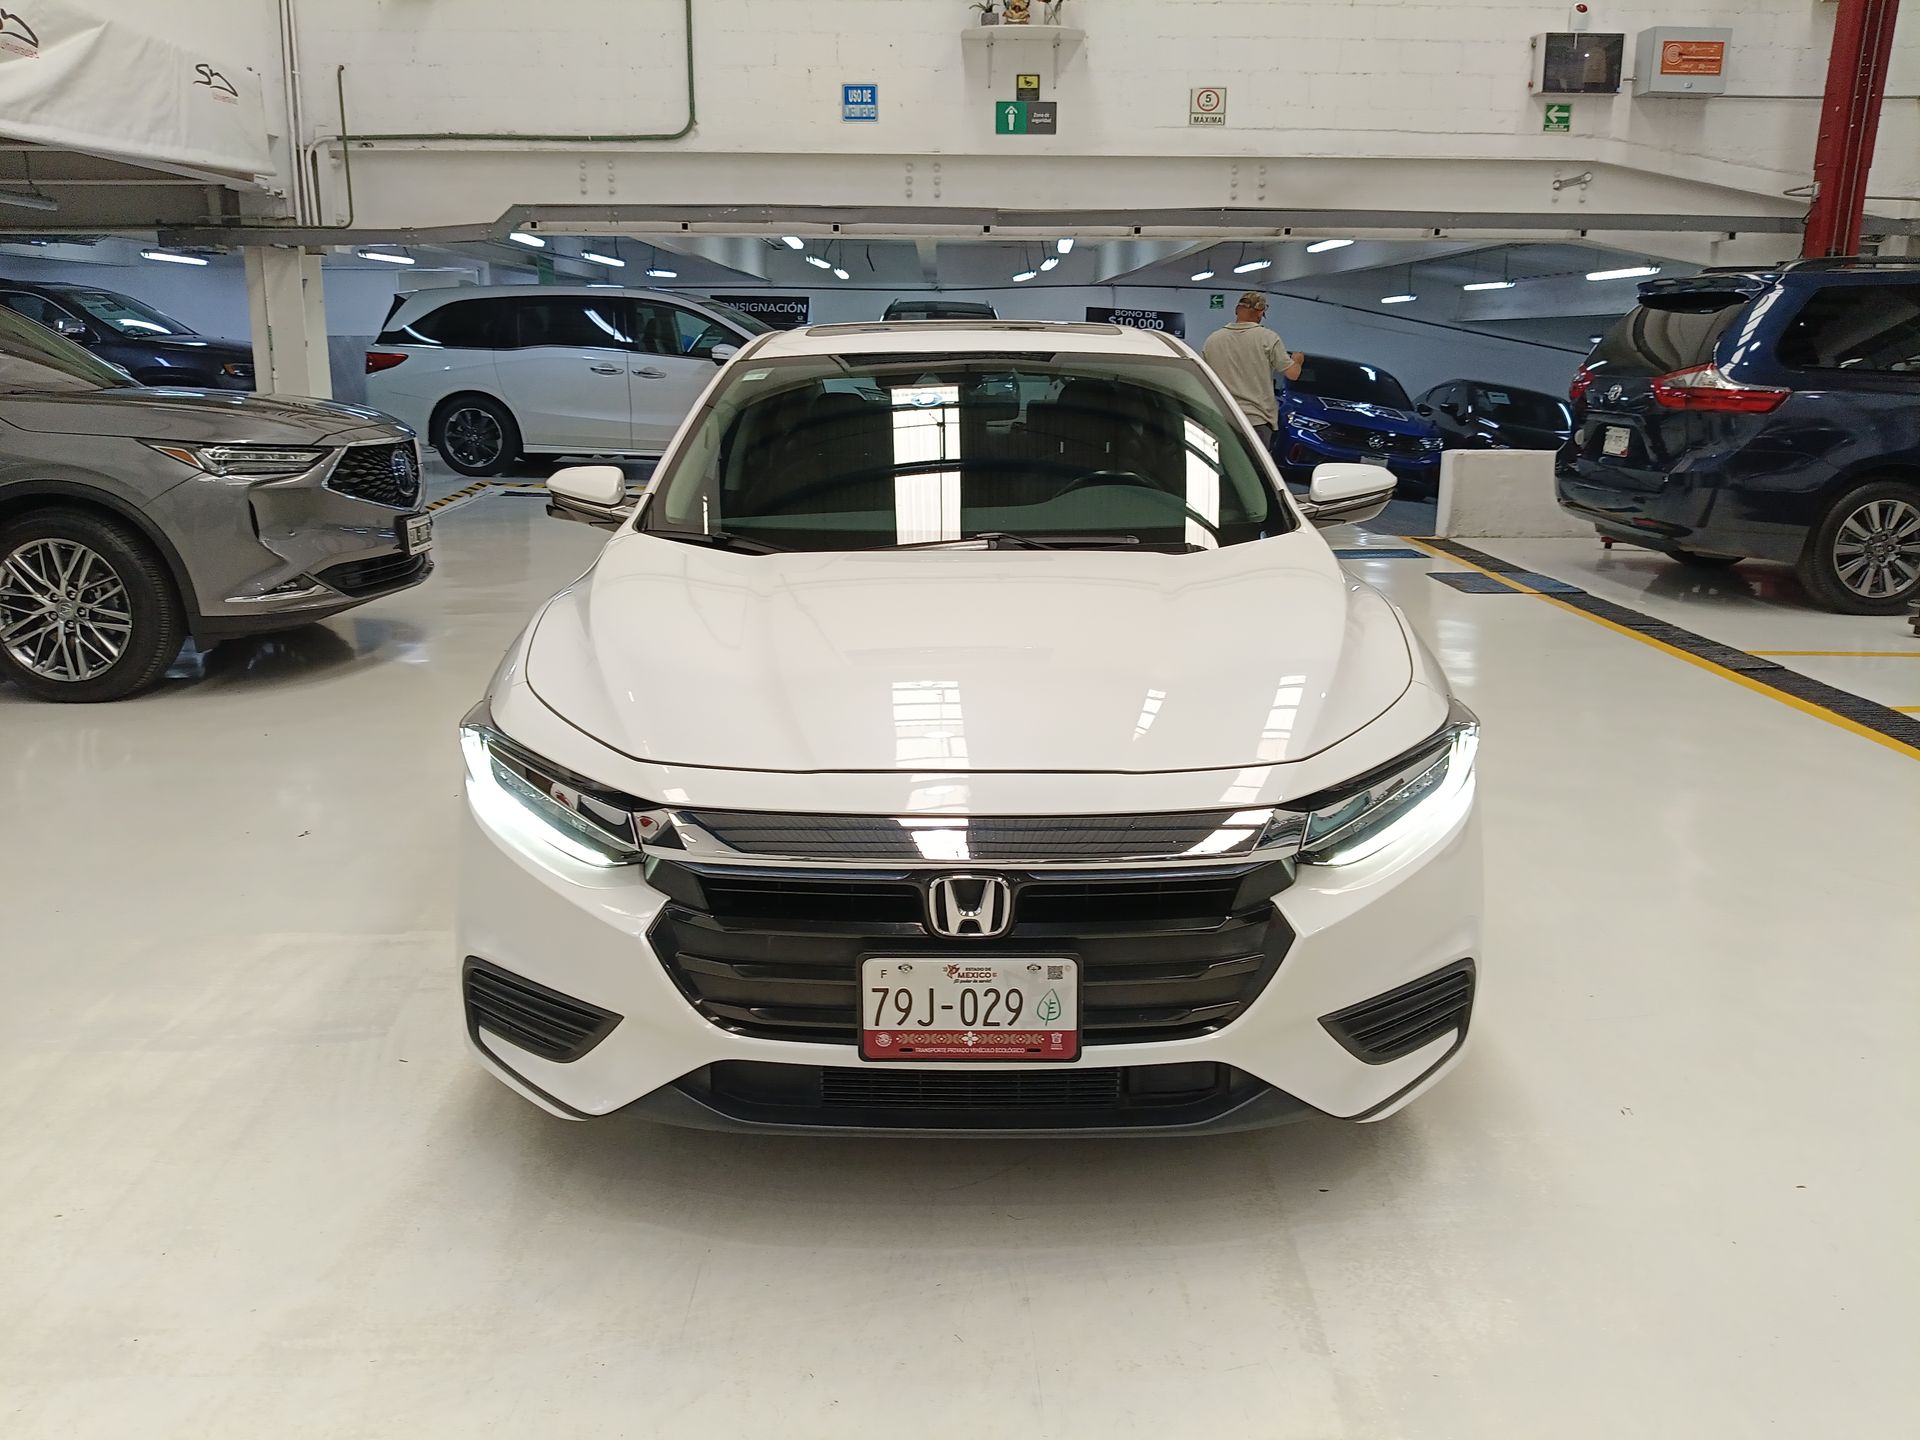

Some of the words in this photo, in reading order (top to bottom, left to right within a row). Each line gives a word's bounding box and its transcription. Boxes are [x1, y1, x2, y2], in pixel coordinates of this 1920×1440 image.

[848, 89, 862, 103] USO
[862, 89, 872, 103] DE
[1205, 93, 1212, 103] 5
[722, 302, 807, 314] ONSIGNACIÓN
[1114, 309, 1143, 318] BONO
[1144, 311, 1158, 319] DE
[880, 969, 888, 979] F
[871, 987, 1024, 1027] 79J-029
